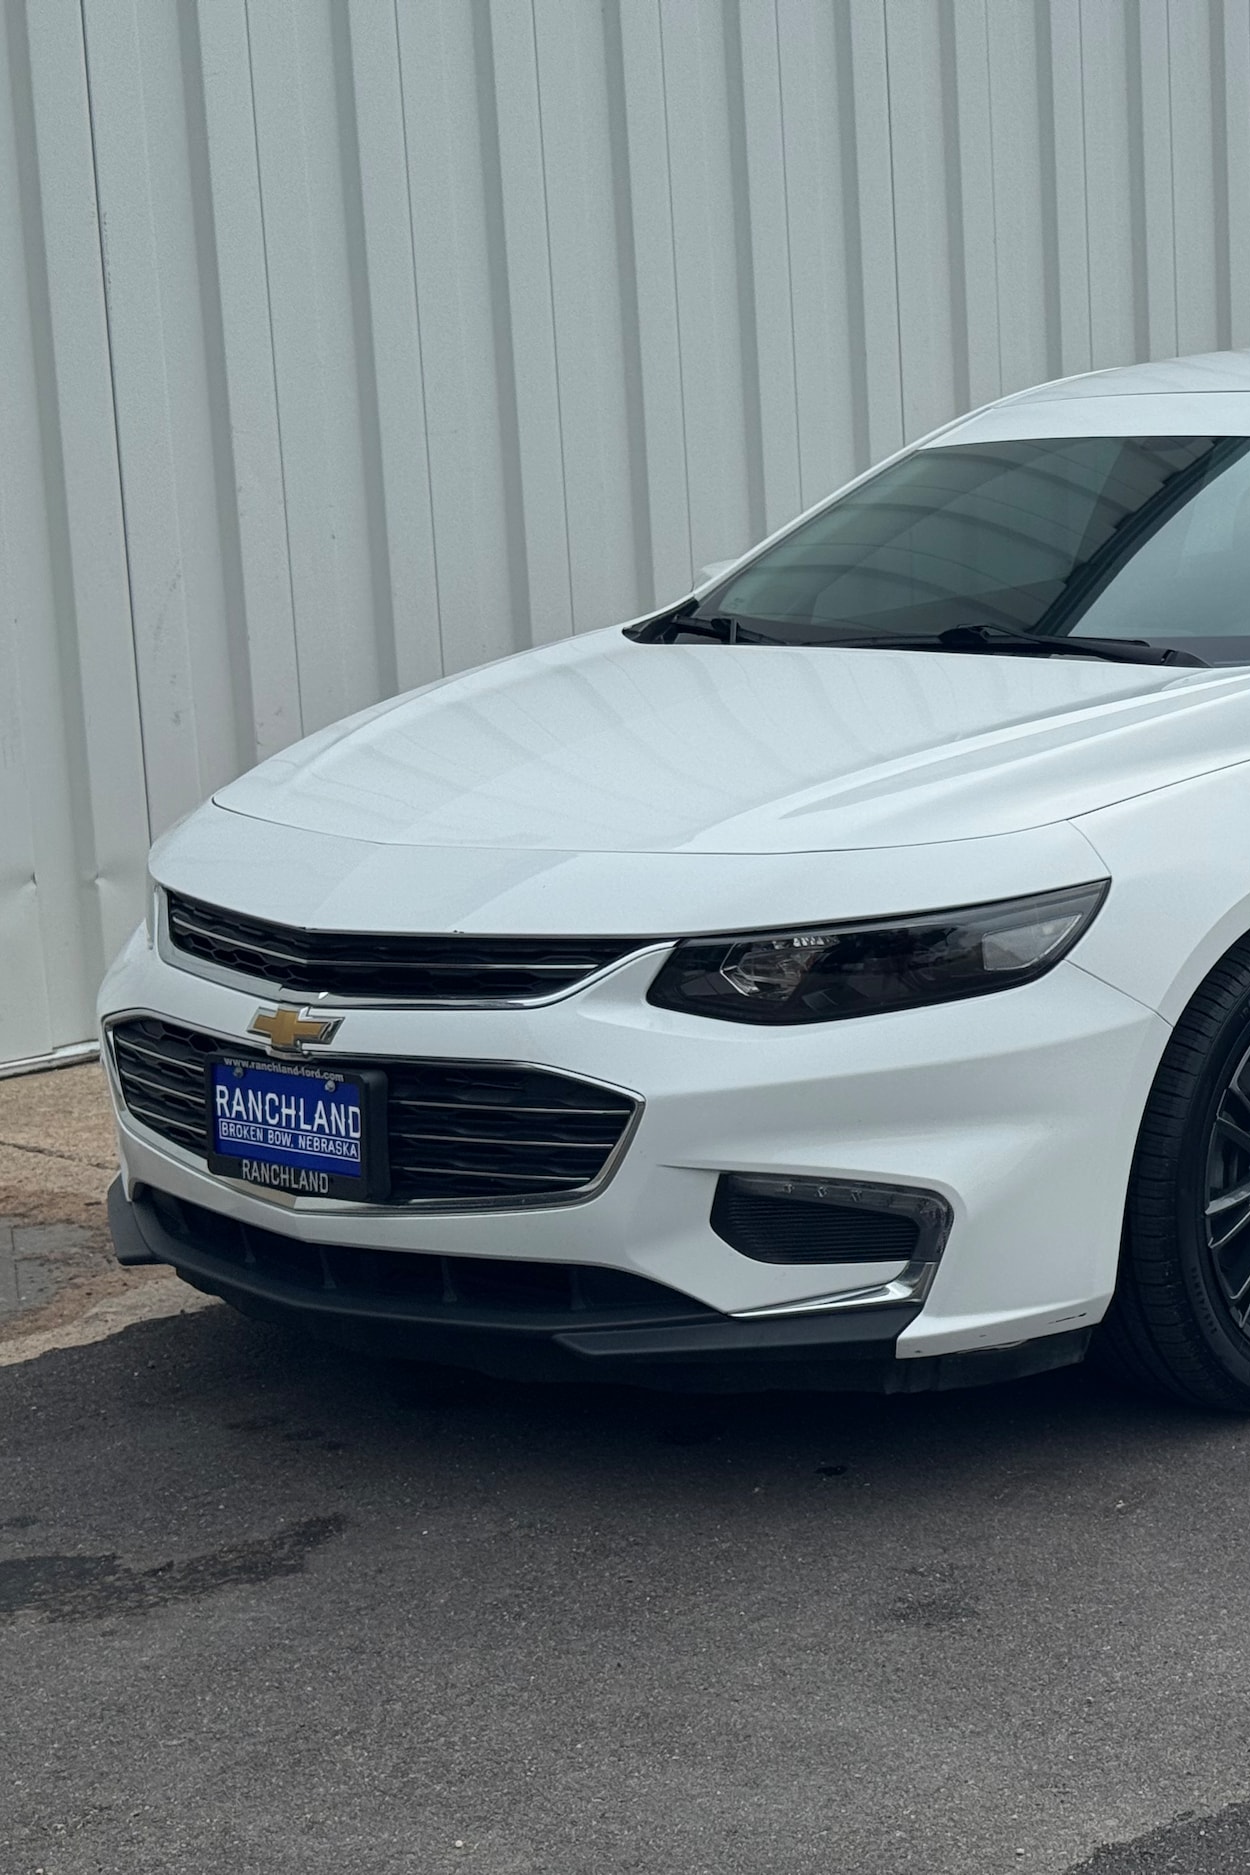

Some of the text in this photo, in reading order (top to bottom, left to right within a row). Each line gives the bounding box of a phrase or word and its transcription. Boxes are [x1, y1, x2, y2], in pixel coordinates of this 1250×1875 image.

[216, 1084, 361, 1139] RANCHLAND
[221, 1122, 264, 1142] BROKEN
[298, 1135, 358, 1158] NEBRASKA
[242, 1160, 329, 1194] RANCHLAND
